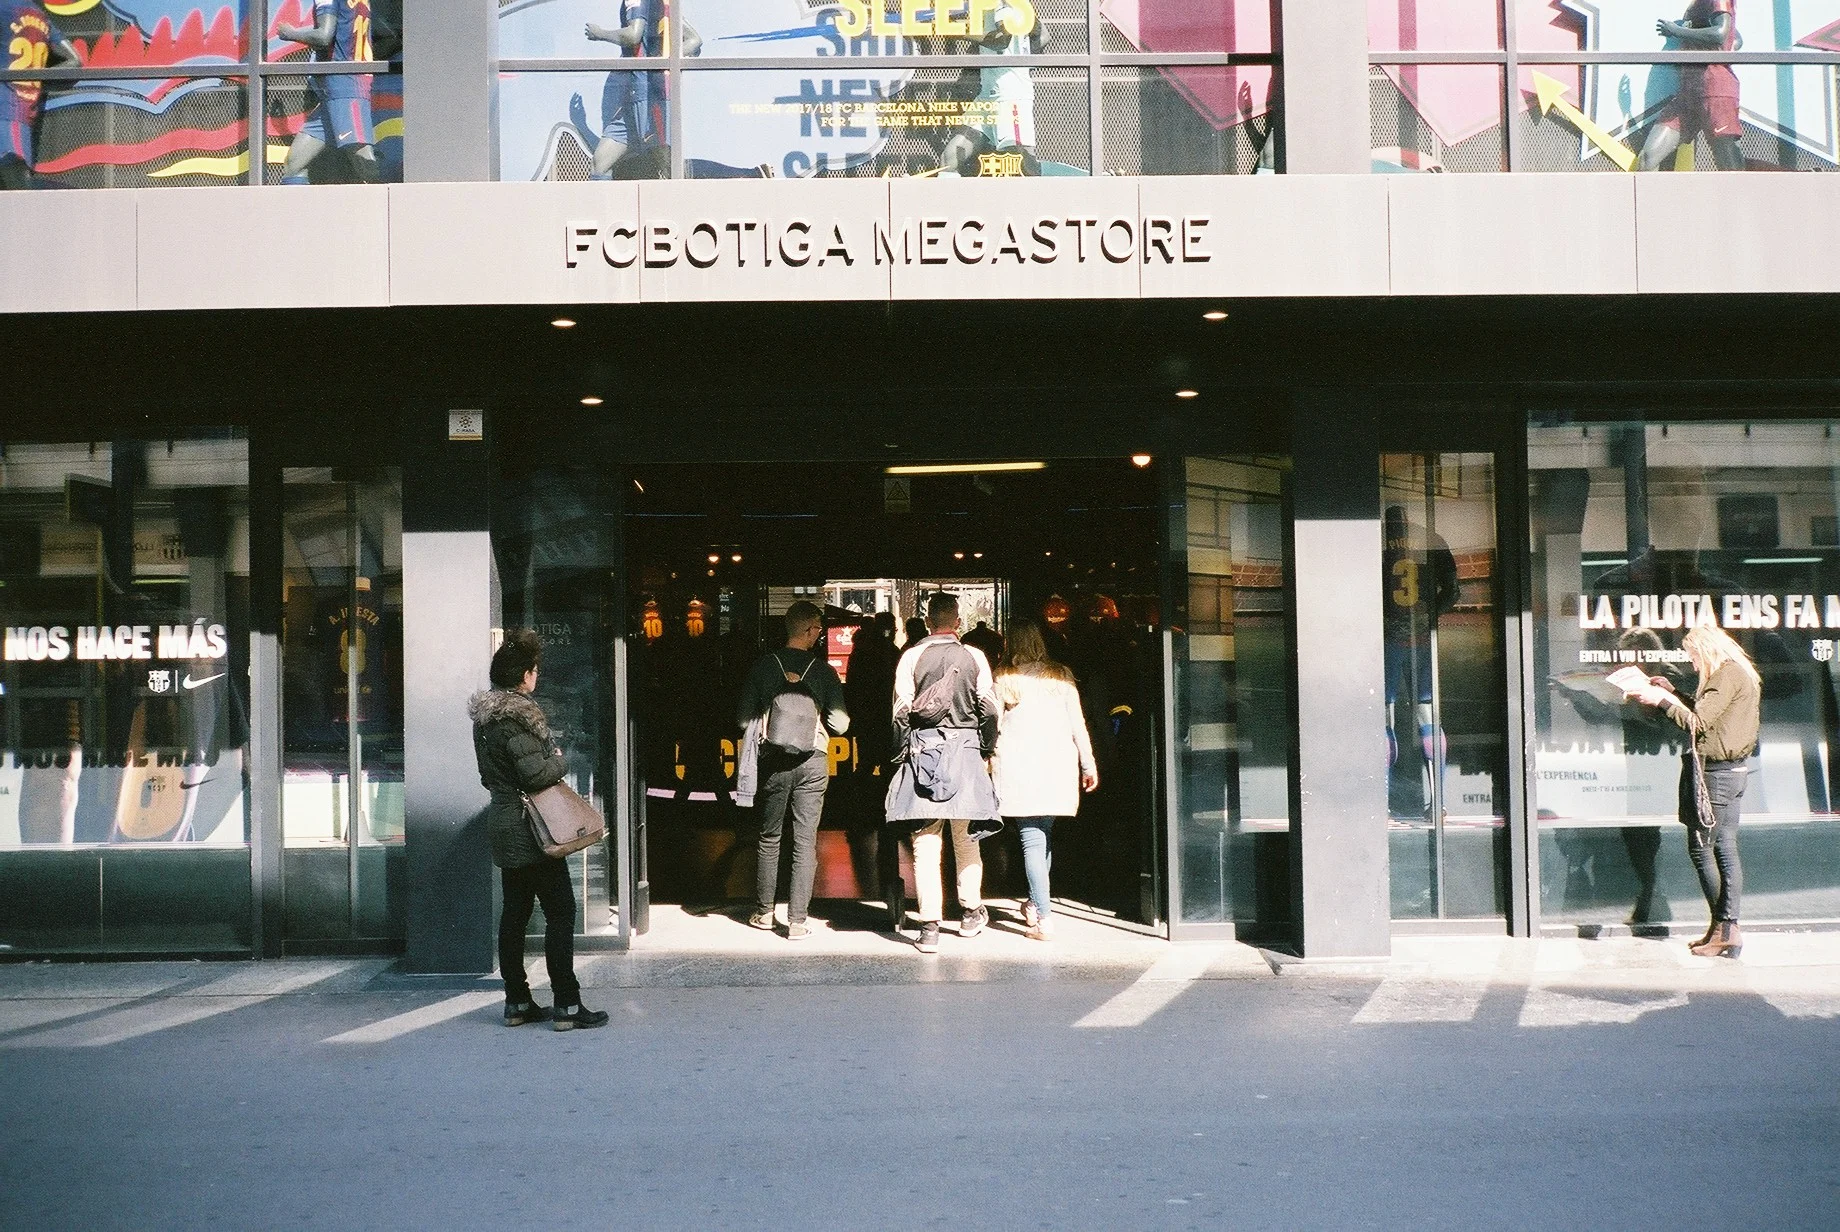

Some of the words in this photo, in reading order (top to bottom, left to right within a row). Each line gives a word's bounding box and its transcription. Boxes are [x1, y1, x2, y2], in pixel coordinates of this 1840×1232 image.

[834, 0, 1035, 36] SLEEPS
[9, 36, 48, 86] 20
[821, 116, 846, 126] FOR
[875, 116, 908, 126] GAME
[911, 116, 942, 126] THAT
[945, 115, 984, 126] NEVER
[855, 101, 925, 112] BARCELONA
[928, 101, 957, 112] NIKE
[565, 219, 854, 269] FCBOTIGA
[873, 214, 1213, 265] MEGASTORE
[1392, 559, 1420, 607] 3
[643, 618, 662, 638] 10
[1580, 594, 1615, 629] LA
[1621, 594, 1718, 629] PILOTA
[1723, 594, 1779, 629] ENS
[1785, 594, 1820, 629] FA
[5, 626, 70, 660] NOS
[77, 625, 151, 659] HACE
[158, 617, 228, 659] MÁS
[1579, 650, 1611, 662] ENTRA
[1613, 650, 1617, 662] I
[1462, 793, 1492, 803] ENTRA
